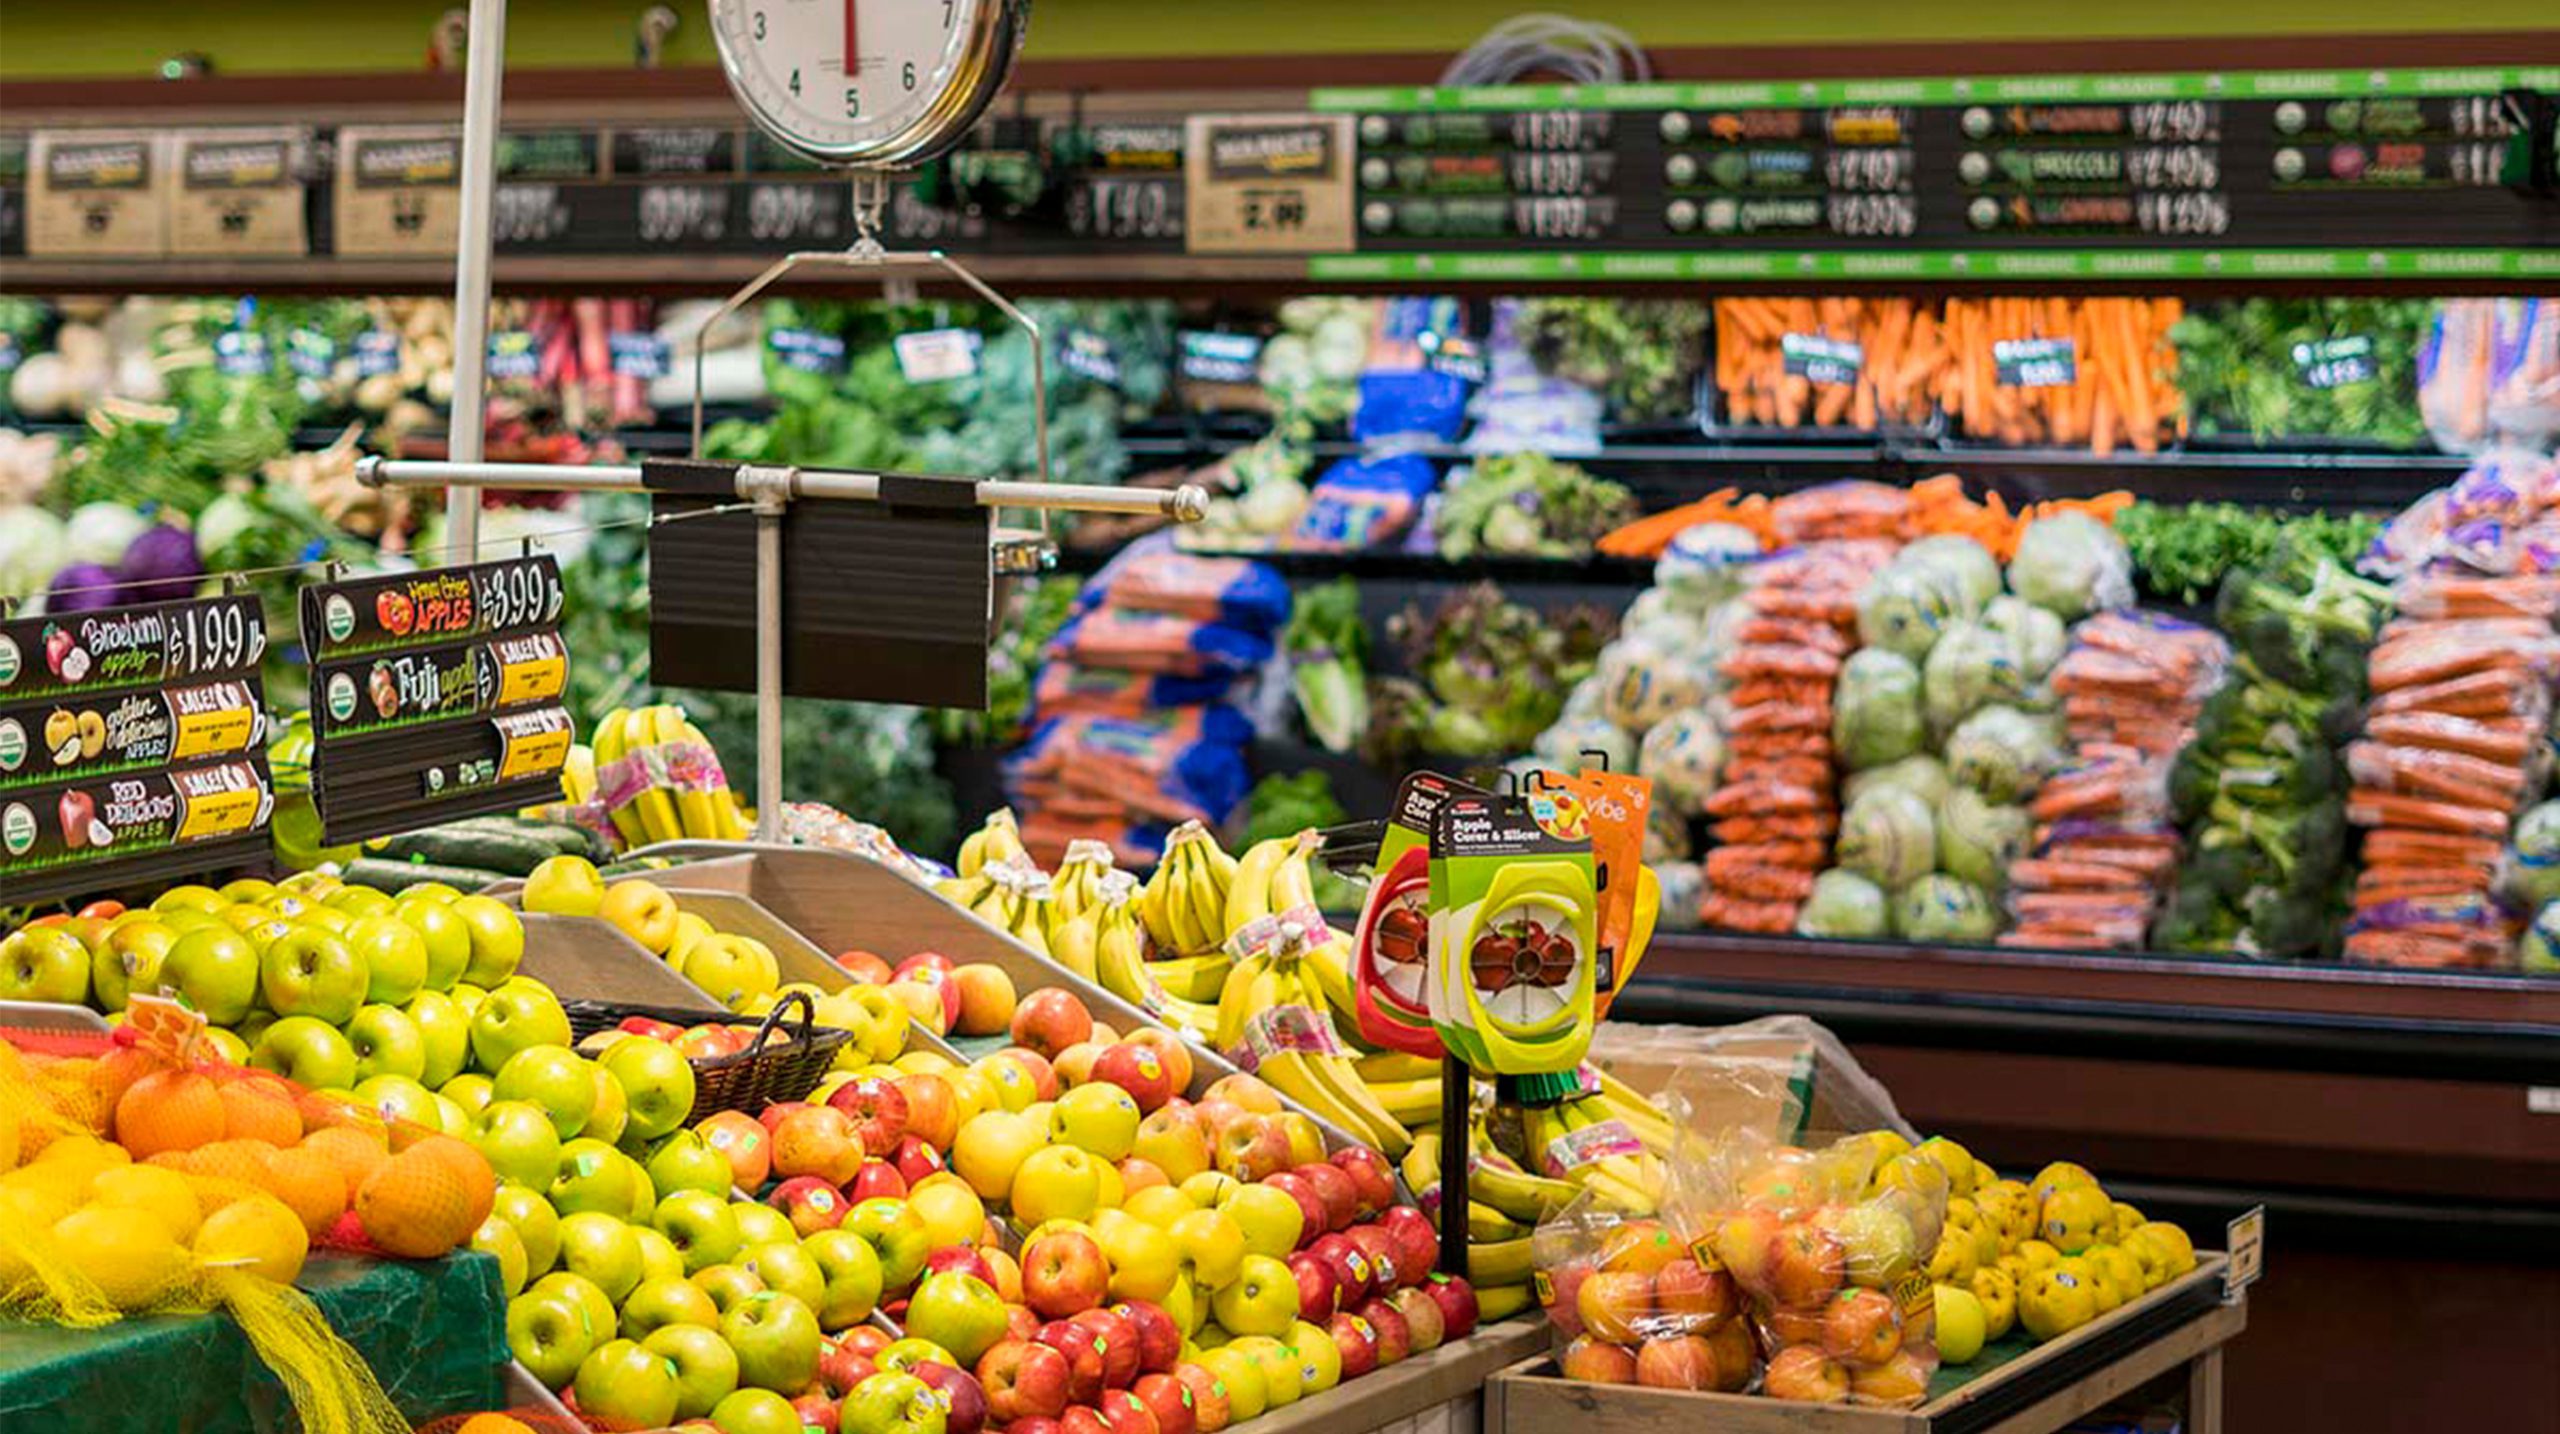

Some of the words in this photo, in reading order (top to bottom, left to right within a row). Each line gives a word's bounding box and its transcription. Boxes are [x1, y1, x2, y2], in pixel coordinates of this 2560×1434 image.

[754, 12, 767, 40] 3
[942, 0, 953, 29] 7
[788, 69, 802, 97] 4
[903, 62, 916, 91] 6
[846, 89, 860, 118] 5
[481, 563, 543, 631] $3.99
[413, 598, 471, 634] APPLES
[169, 603, 244, 676] $1.99
[395, 655, 441, 711] Fuji
[111, 780, 147, 803] RED
[104, 794, 175, 826] DELICIOUS
[115, 821, 164, 839] APPLES
[1452, 817, 1492, 834] Apple
[1453, 831, 1489, 843] Corer
[1491, 831, 1501, 842] &
[1502, 828, 1541, 842] Slicer
